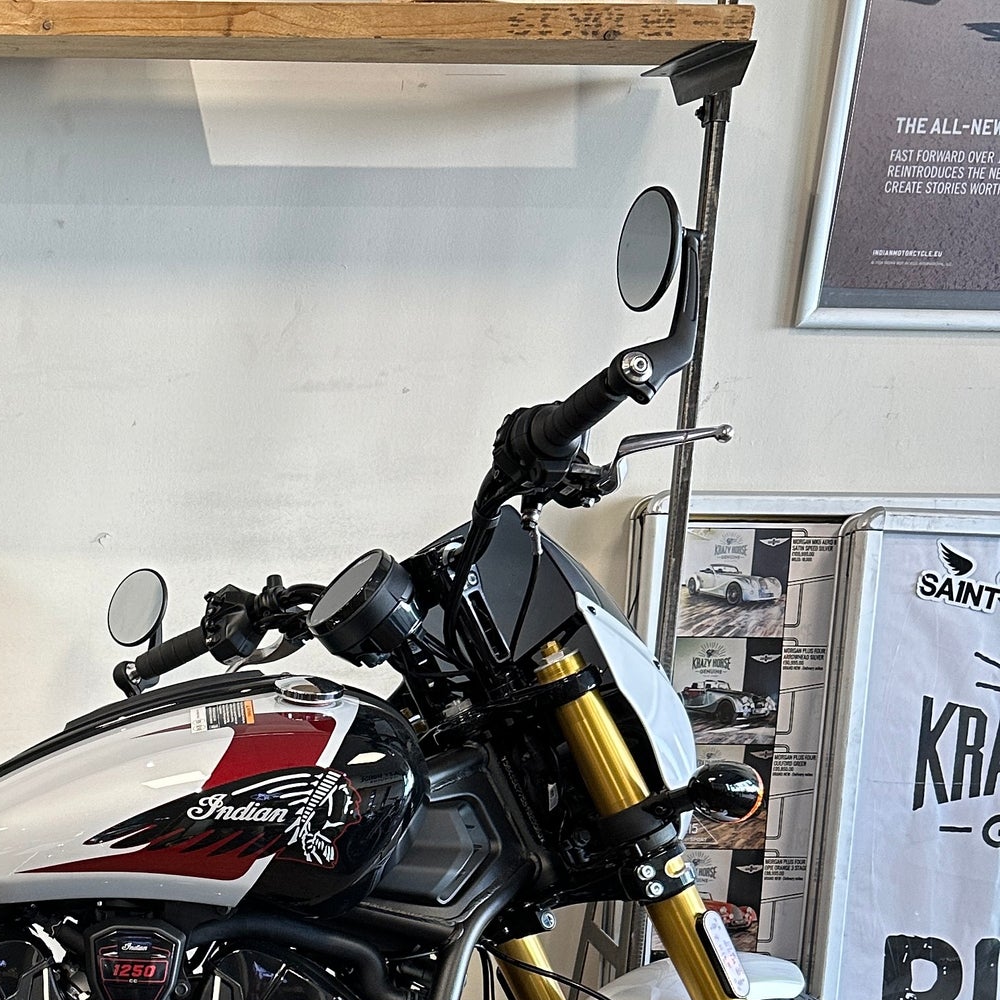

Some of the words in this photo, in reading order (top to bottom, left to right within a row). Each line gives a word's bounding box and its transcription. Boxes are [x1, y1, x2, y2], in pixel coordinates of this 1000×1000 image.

[896, 117, 928, 134] THE
[889, 149, 914, 162] FAST
[916, 149, 965, 163] FORWARD
[967, 150, 995, 164] OVER
[887, 165, 964, 179] REINTRODUCES
[967, 166, 986, 180] THE
[884, 180, 923, 194] CREATE
[925, 181, 967, 195] STORIES
[872, 249, 943, 258] INDIANMOTORCYCLE.EU
[919, 573, 1000, 610] SAINT
[692, 656, 711, 670] KRAZY
[711, 656, 731, 671] HORSE
[186, 793, 289, 823] Indian
[121, 942, 148, 951] Indian
[113, 964, 157, 978] 1250
